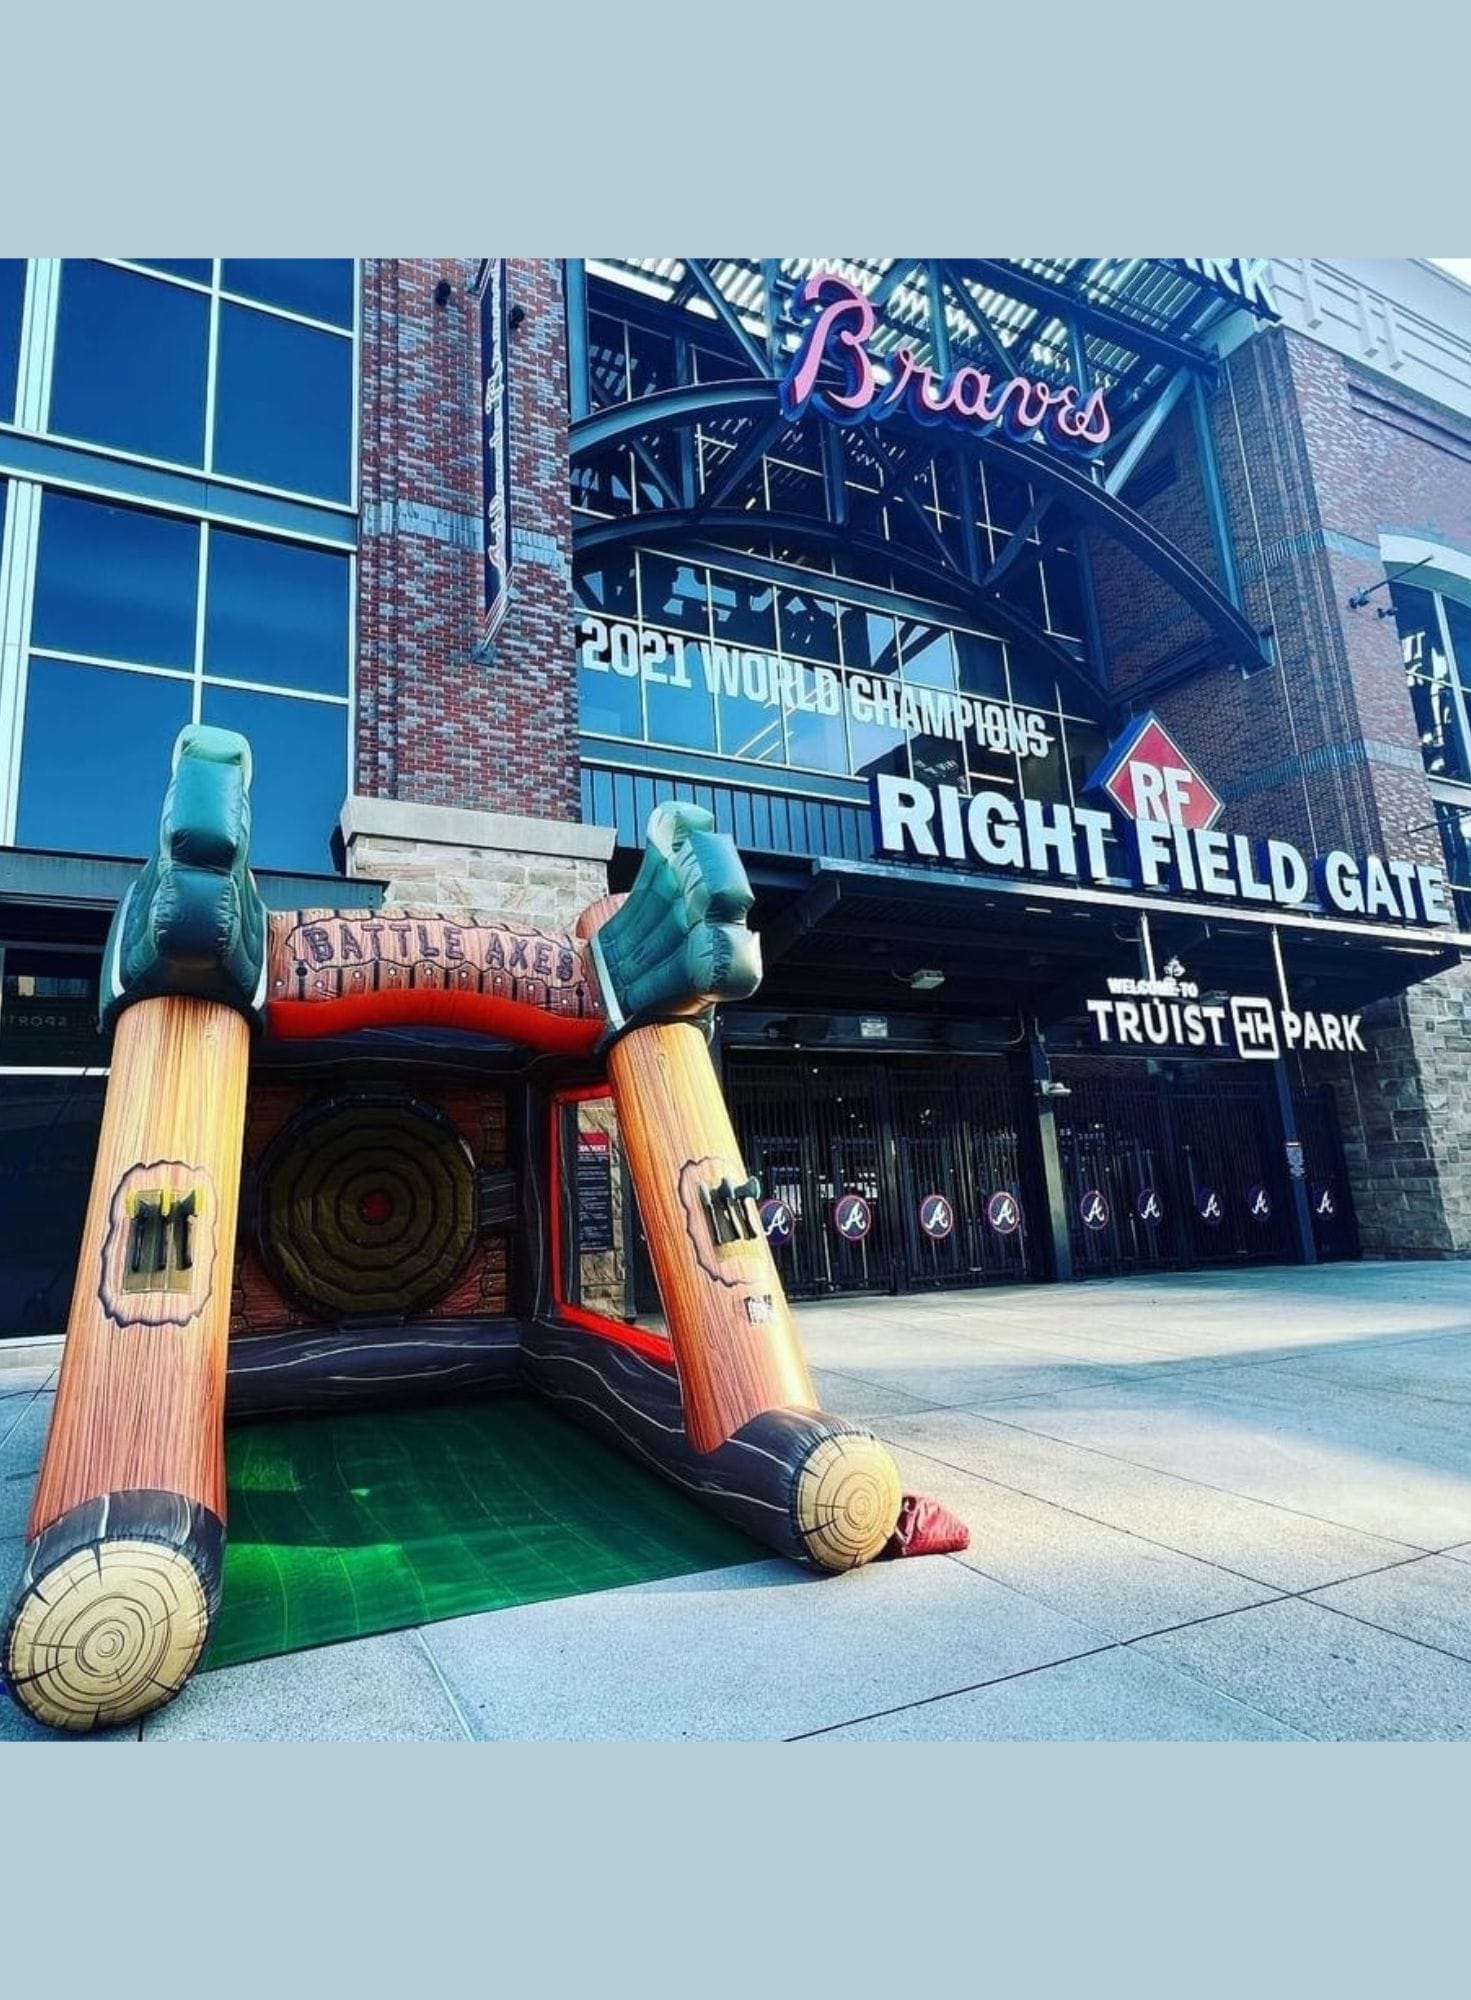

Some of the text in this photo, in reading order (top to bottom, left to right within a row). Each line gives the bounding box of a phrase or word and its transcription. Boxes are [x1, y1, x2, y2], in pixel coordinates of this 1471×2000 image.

[793, 273, 1111, 444] Braves
[581, 617, 1053, 759] 2021 WORLD CHAMPIONS
[1128, 760, 1194, 829] RF
[876, 773, 1451, 925] RIGHT FIELD GATE
[302, 923, 574, 982] BATTLE AXES
[1107, 977, 1199, 998] WELCOME TO
[1087, 999, 1225, 1046] TRUIST
[1281, 1010, 1368, 1052] PARK
